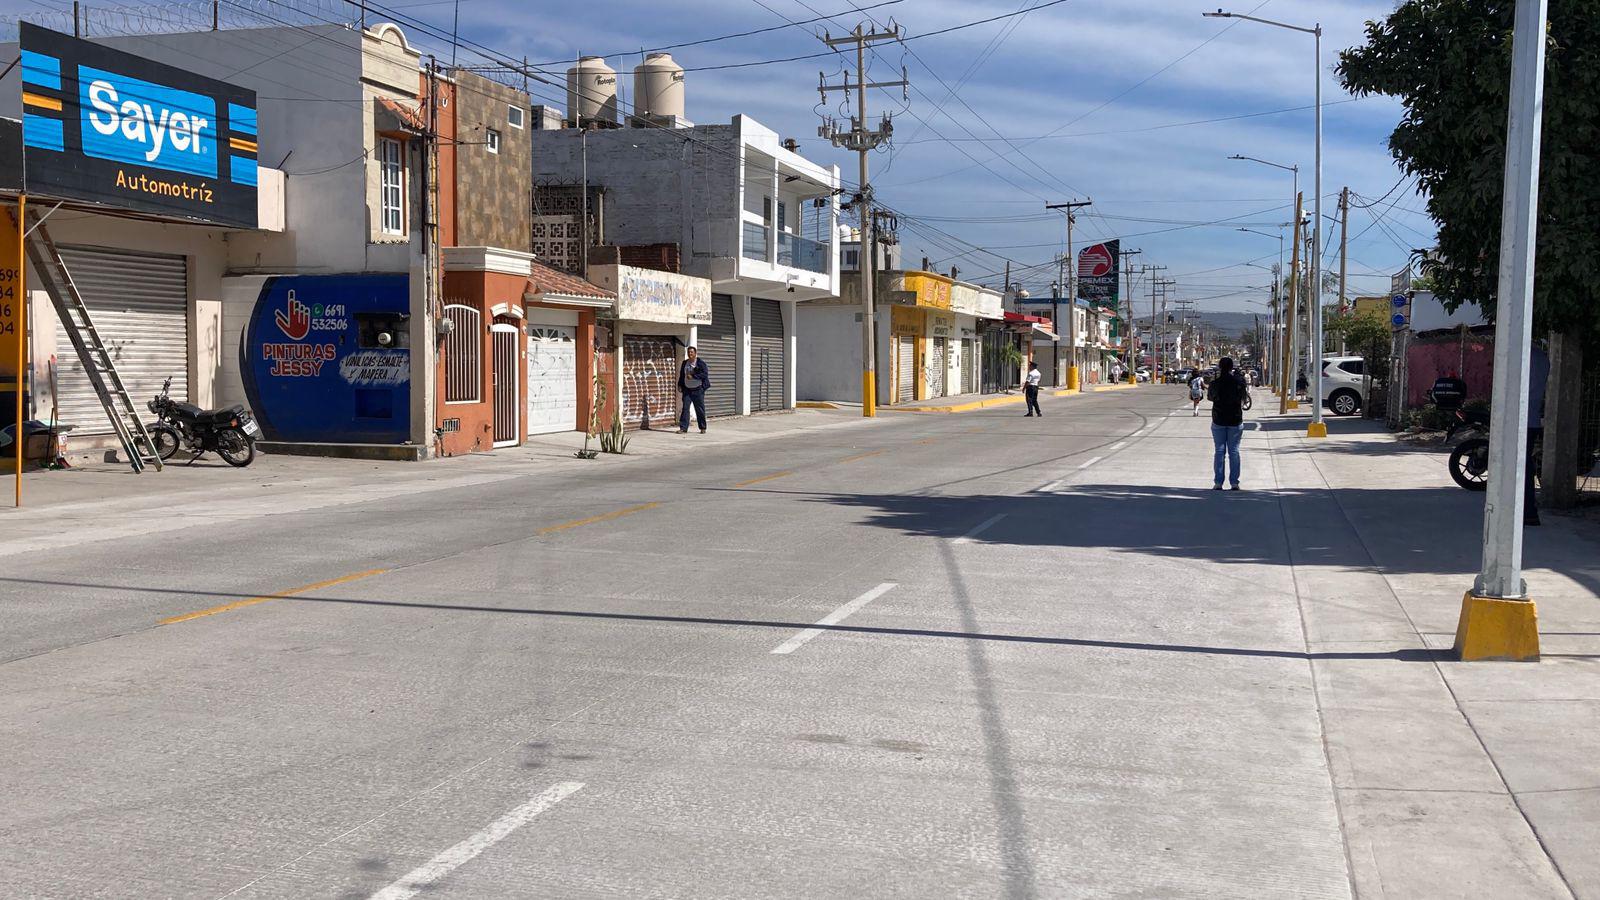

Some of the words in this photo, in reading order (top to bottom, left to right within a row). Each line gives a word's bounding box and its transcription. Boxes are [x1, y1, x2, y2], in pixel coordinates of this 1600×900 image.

[89, 80, 208, 162] Sayer
[116, 169, 213, 203] Automotríz
[324, 304, 345, 317] 6691
[311, 318, 348, 331] 532506
[263, 343, 336, 360] PINTURAS
[271, 360, 324, 377] JESSY
